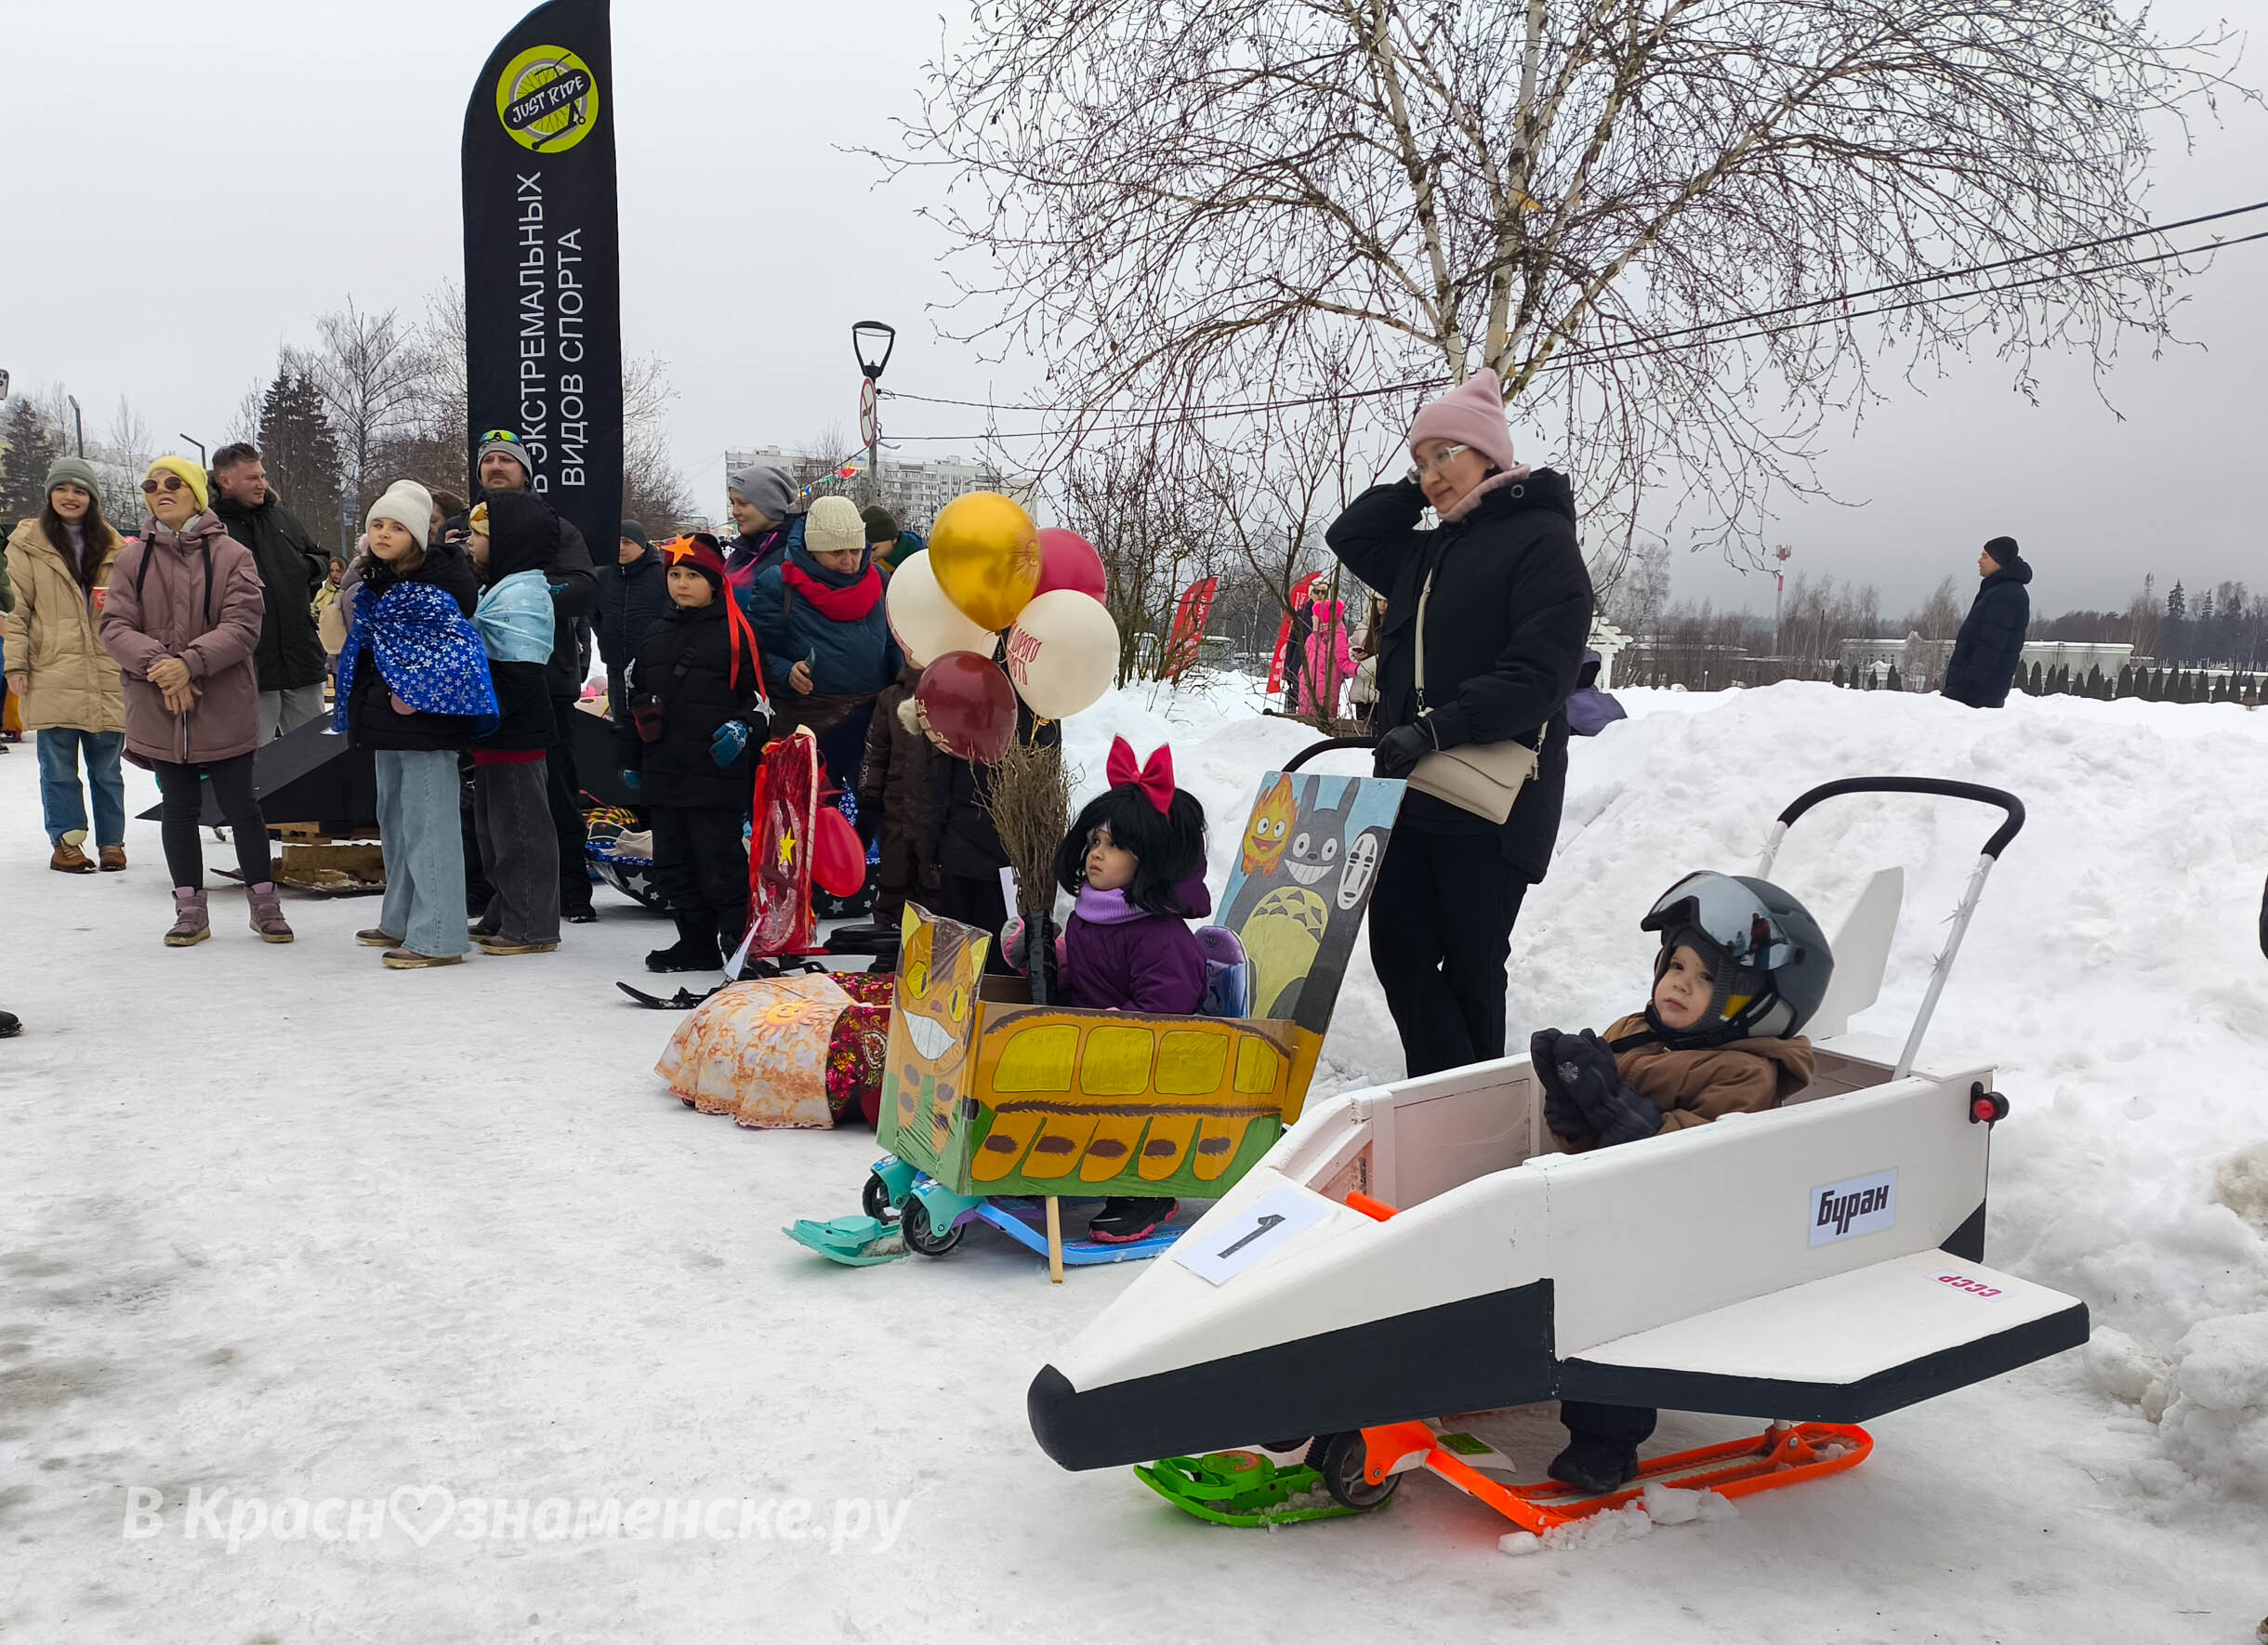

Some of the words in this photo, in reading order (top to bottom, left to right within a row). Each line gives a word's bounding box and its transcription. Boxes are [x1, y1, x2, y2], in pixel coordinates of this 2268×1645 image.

[512, 91, 545, 123] JUST
[547, 75, 584, 106] RIDE
[517, 171, 547, 464] ЭКСТРЕМАЛЬНЫХ
[558, 228, 584, 362] СПОРТА
[560, 374, 588, 486] ВИДОВ
[1217, 1214, 1286, 1259] 1
[1938, 1275, 2002, 1297] СССР
